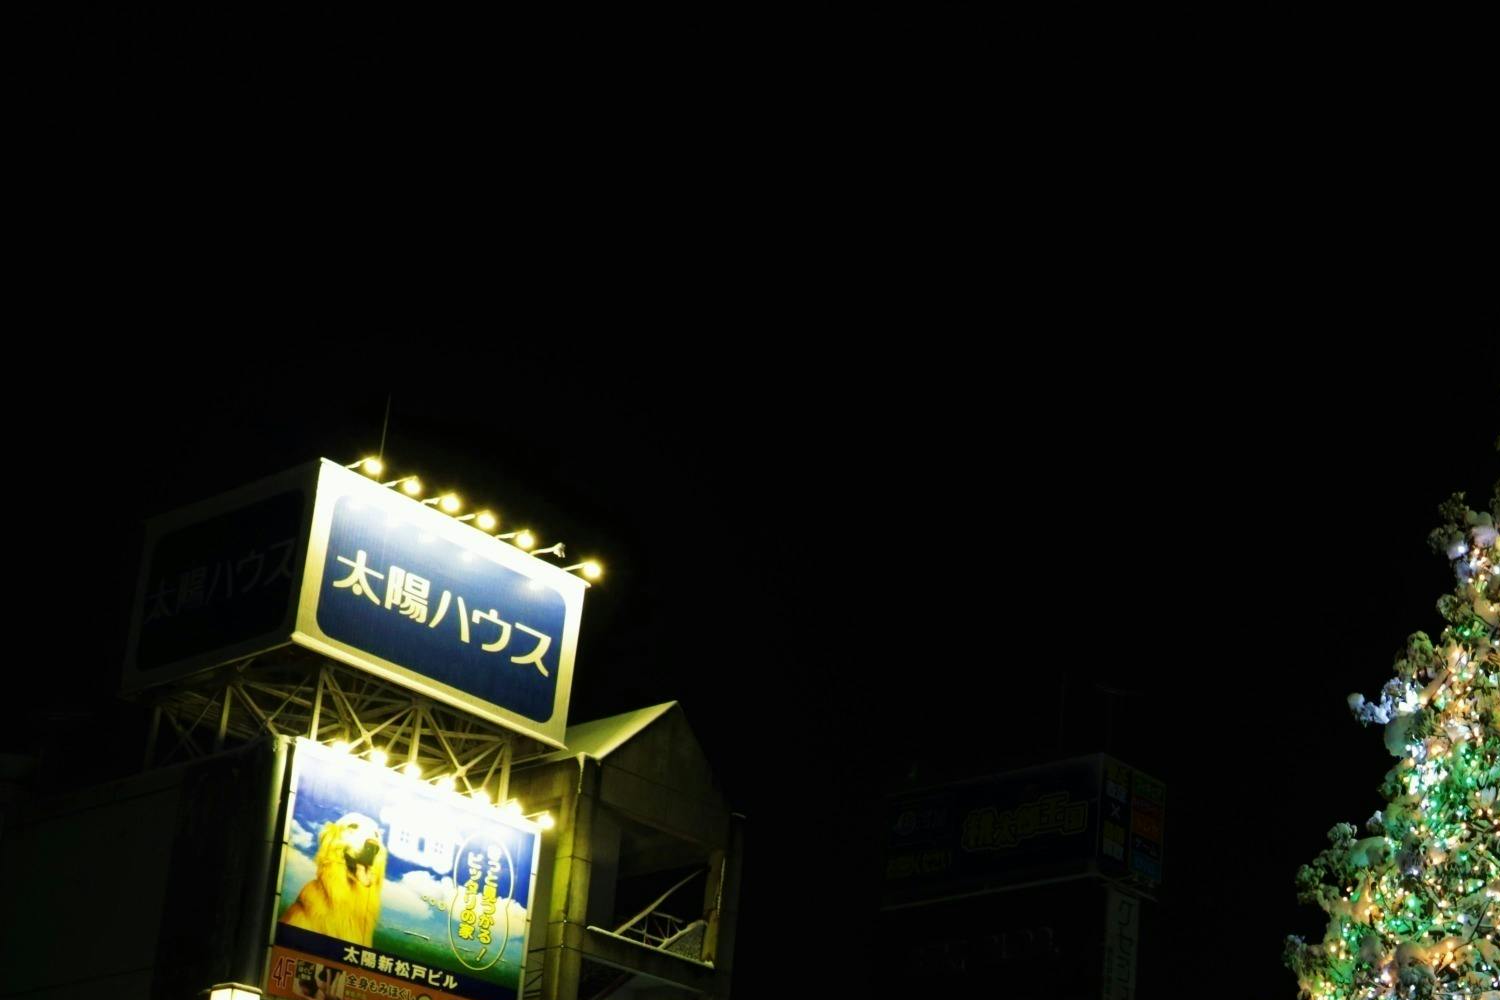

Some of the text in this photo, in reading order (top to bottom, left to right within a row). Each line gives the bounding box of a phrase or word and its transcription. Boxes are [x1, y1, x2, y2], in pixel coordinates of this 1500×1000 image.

[332, 549, 552, 678] 太陽ハウス
[272, 955, 297, 990] 4F
[343, 945, 458, 991] 太陽新松戸ビル
